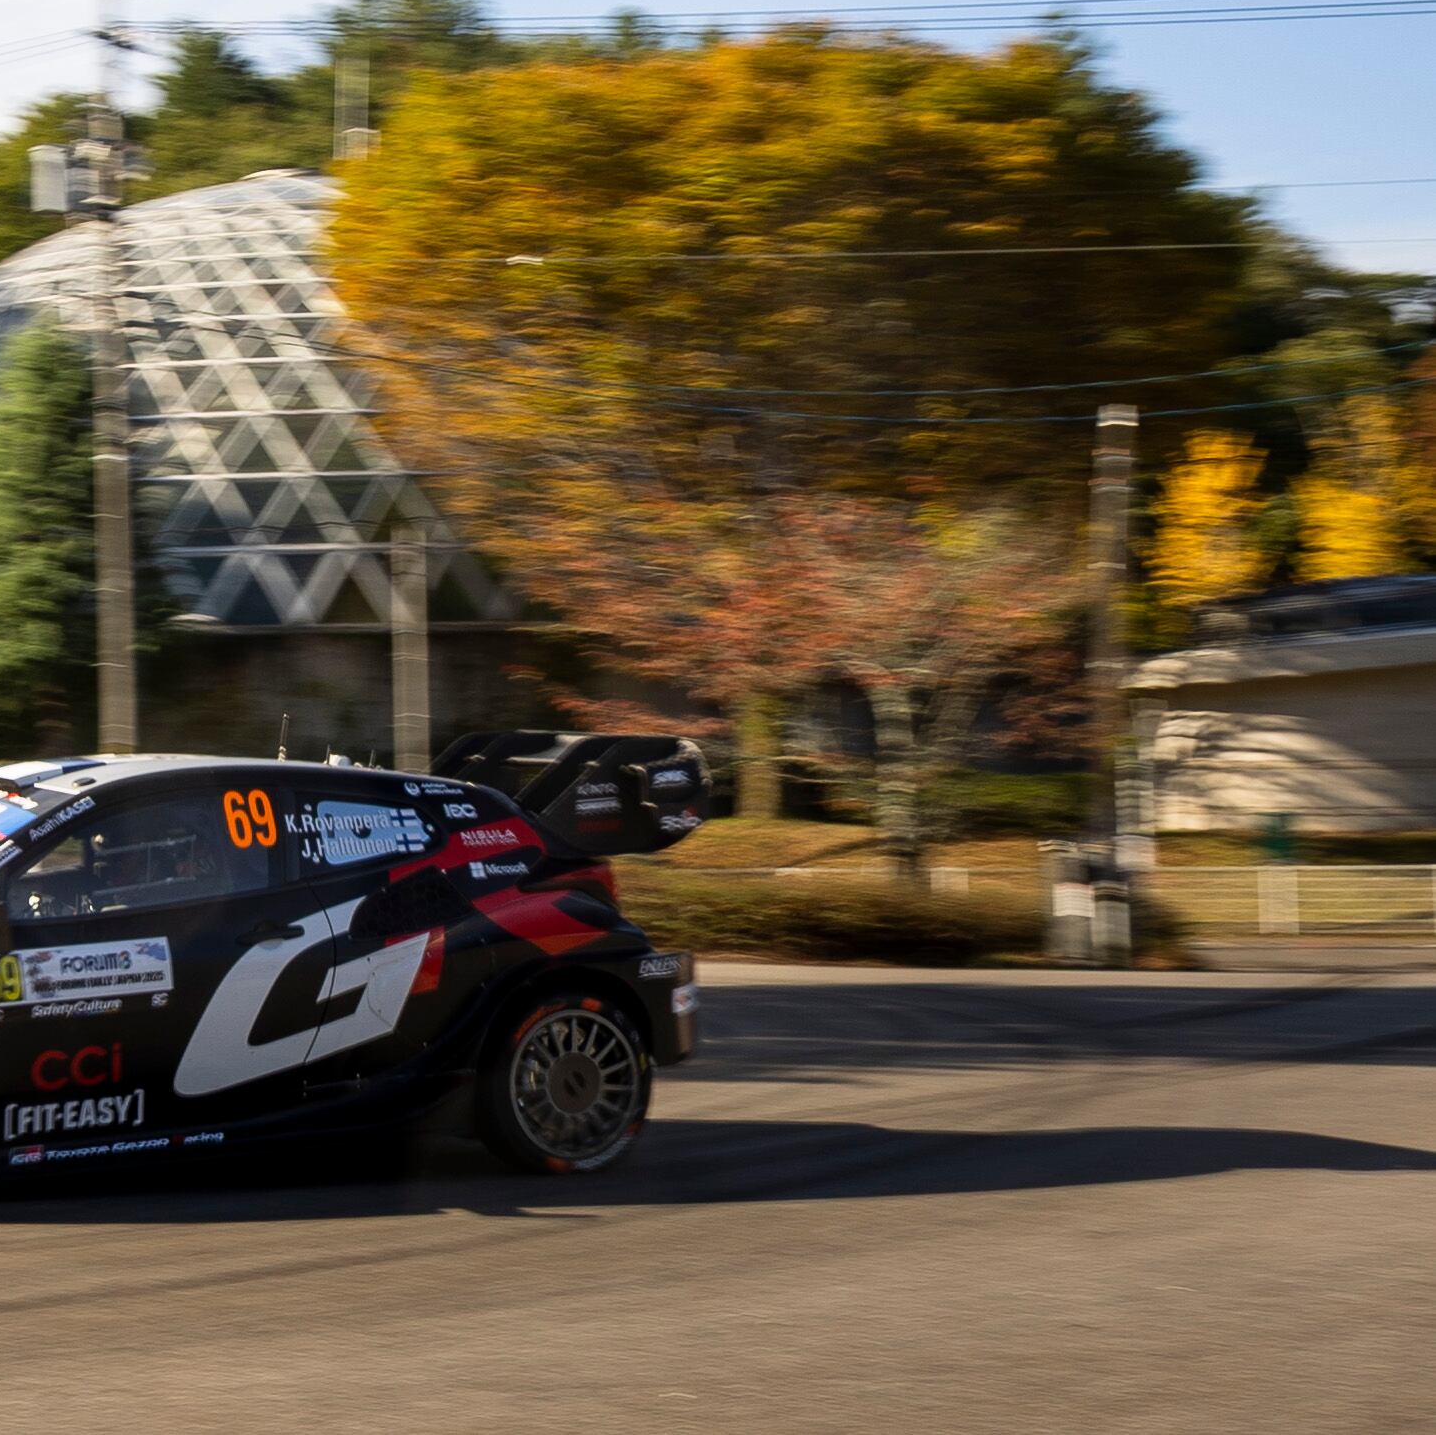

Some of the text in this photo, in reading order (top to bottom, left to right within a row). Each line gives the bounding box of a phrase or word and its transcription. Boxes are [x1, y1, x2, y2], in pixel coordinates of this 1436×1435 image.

[223, 788, 278, 849] 69
[284, 810, 391, 834] K.Rovanperä
[302, 837, 397, 859] J.Halttunen
